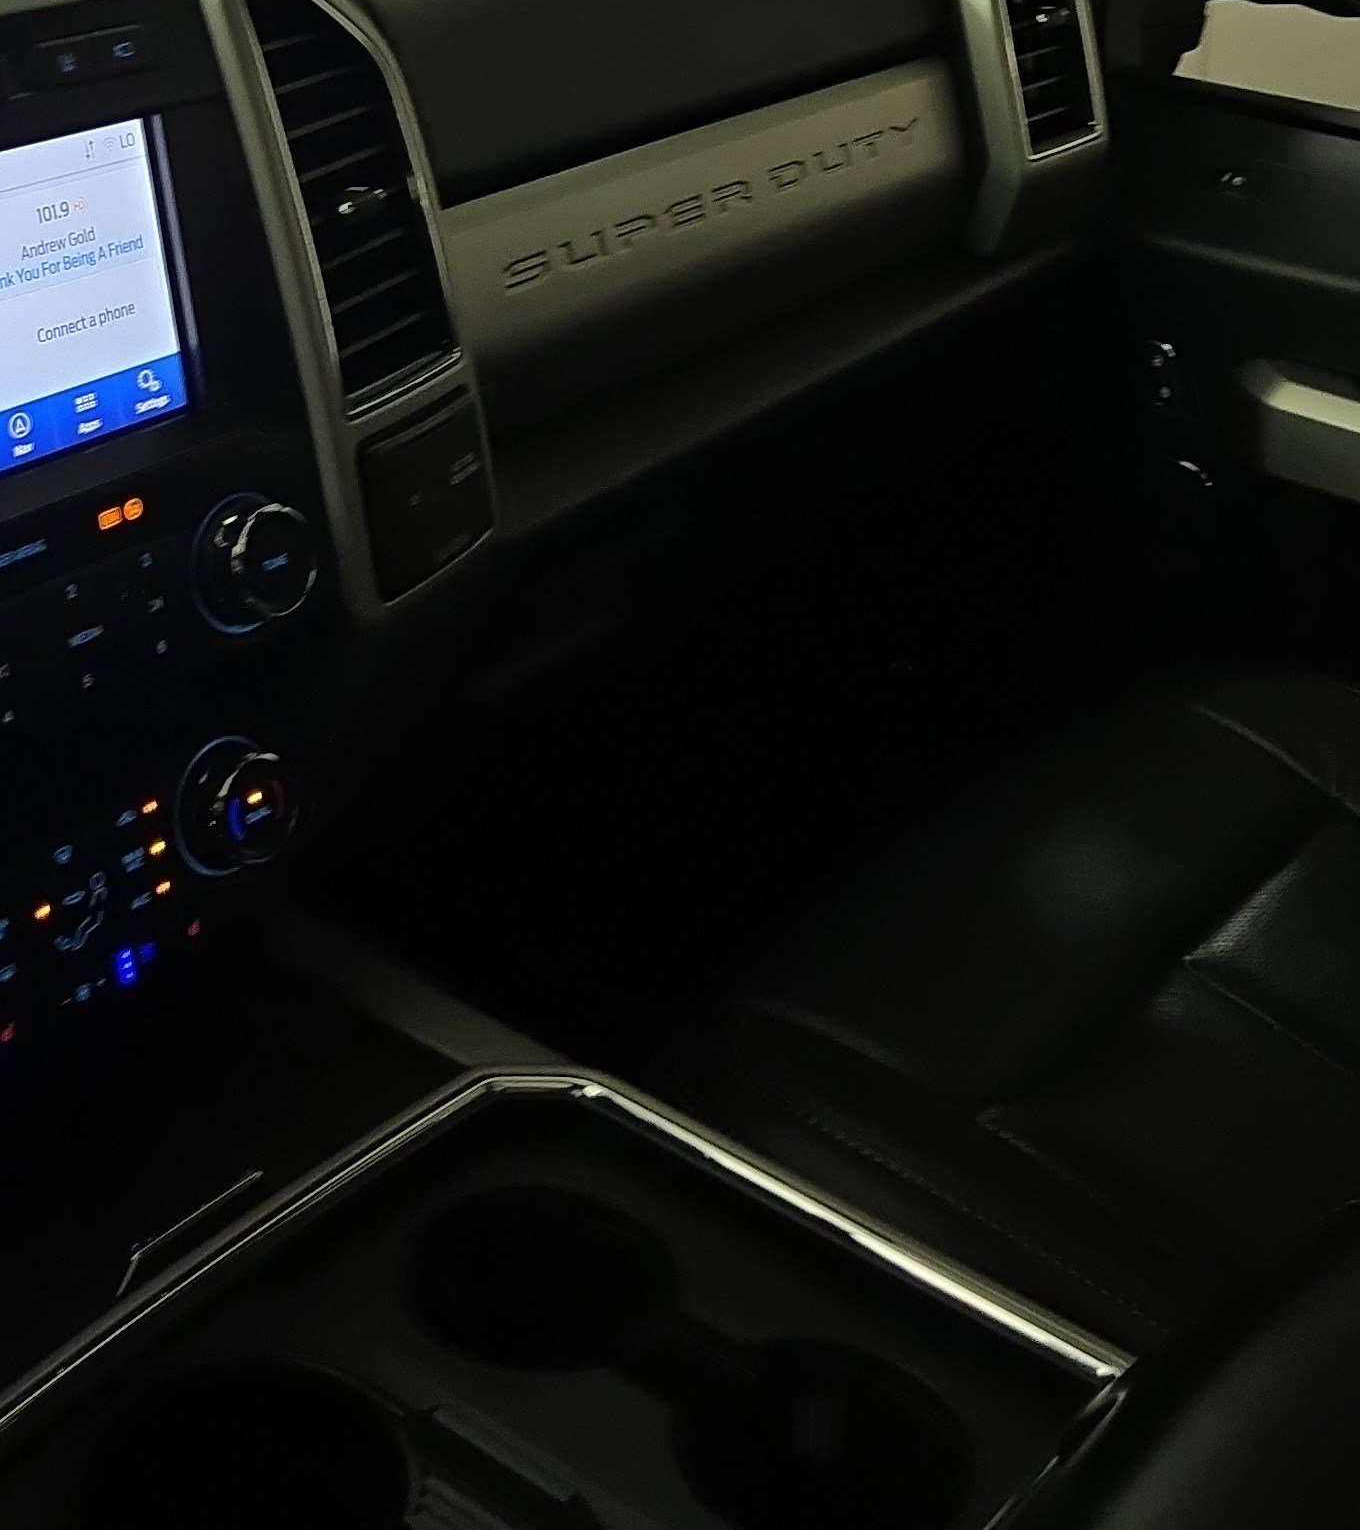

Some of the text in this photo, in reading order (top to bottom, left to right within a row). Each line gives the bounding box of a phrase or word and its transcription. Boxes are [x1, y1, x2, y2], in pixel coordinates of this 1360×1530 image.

[119, 132, 136, 149] LO
[36, 201, 70, 224] 101.9
[503, 118, 919, 292] SUPER DUTY
[16, 265, 39, 284] You
[41, 259, 61, 277] For
[63, 250, 97, 270] Being
[98, 246, 107, 260] A
[108, 234, 144, 257] Friend
[21, 226, 96, 261] Andrew Gold
[37, 303, 136, 343] Connect a phone
